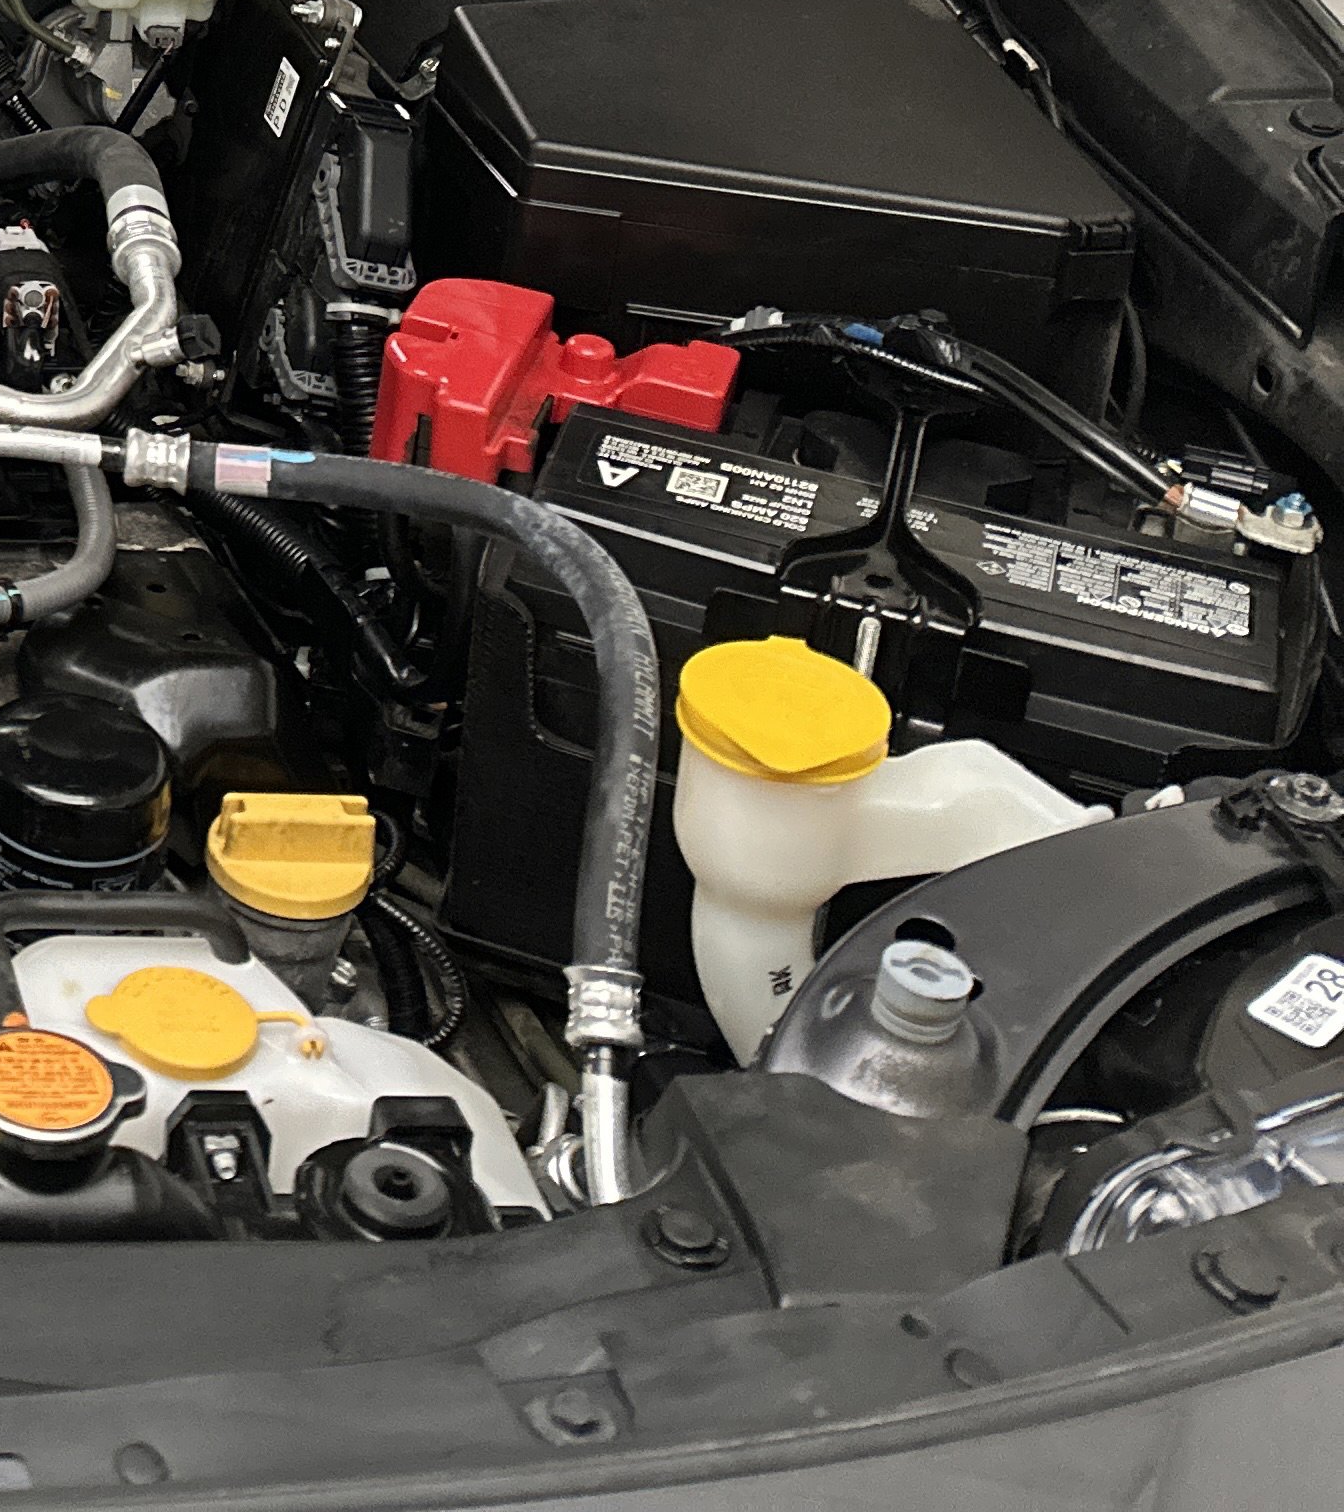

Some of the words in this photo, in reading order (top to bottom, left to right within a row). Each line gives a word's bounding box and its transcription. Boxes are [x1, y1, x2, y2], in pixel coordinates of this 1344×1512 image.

[674, 494, 709, 508] AMPS
[730, 499, 778, 518] AMPS
[768, 499, 811, 516] GROUP
[709, 502, 771, 524] CRANKING
[772, 517, 806, 532] COLD
